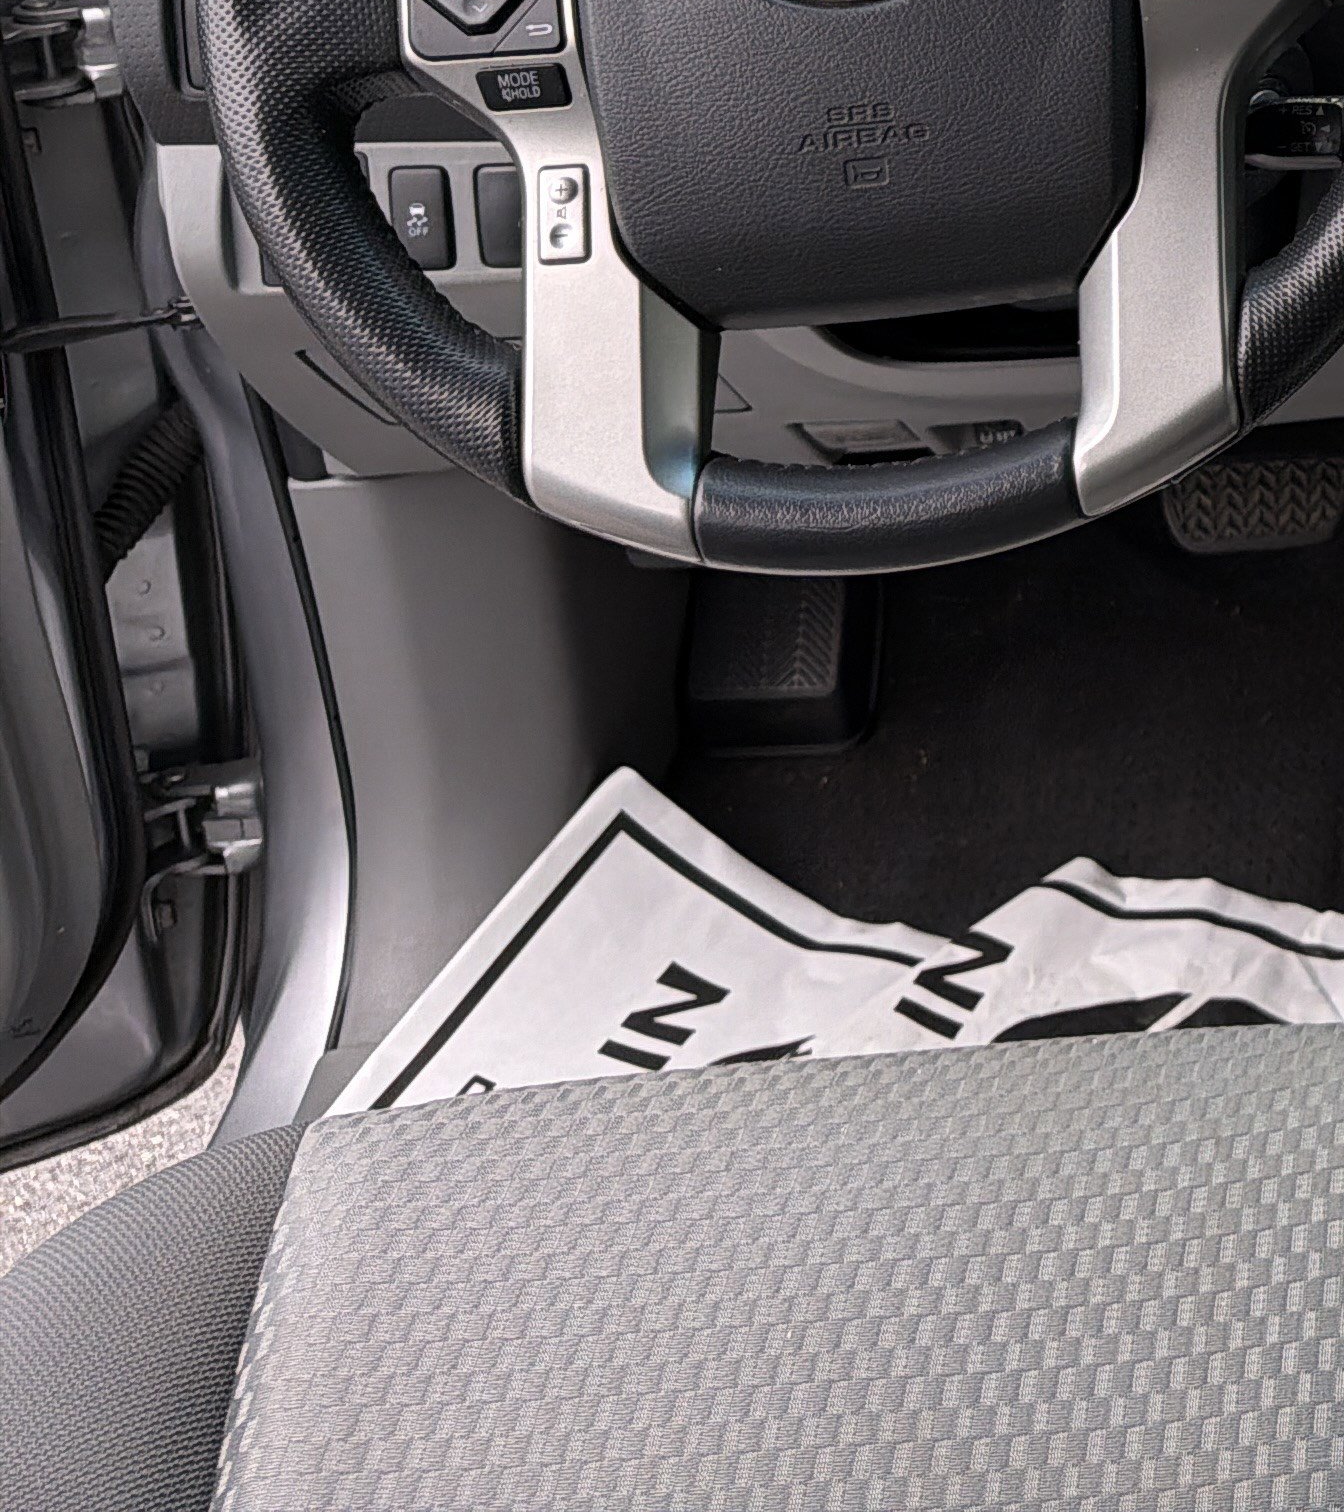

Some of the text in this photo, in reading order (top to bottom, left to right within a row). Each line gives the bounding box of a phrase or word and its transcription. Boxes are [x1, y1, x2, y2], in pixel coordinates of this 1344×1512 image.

[498, 70, 540, 88] MODE
[511, 86, 541, 99] HOLD
[798, 122, 930, 153] AIRBAG
[408, 226, 429, 237] OFF
[597, 960, 732, 1072] IN
